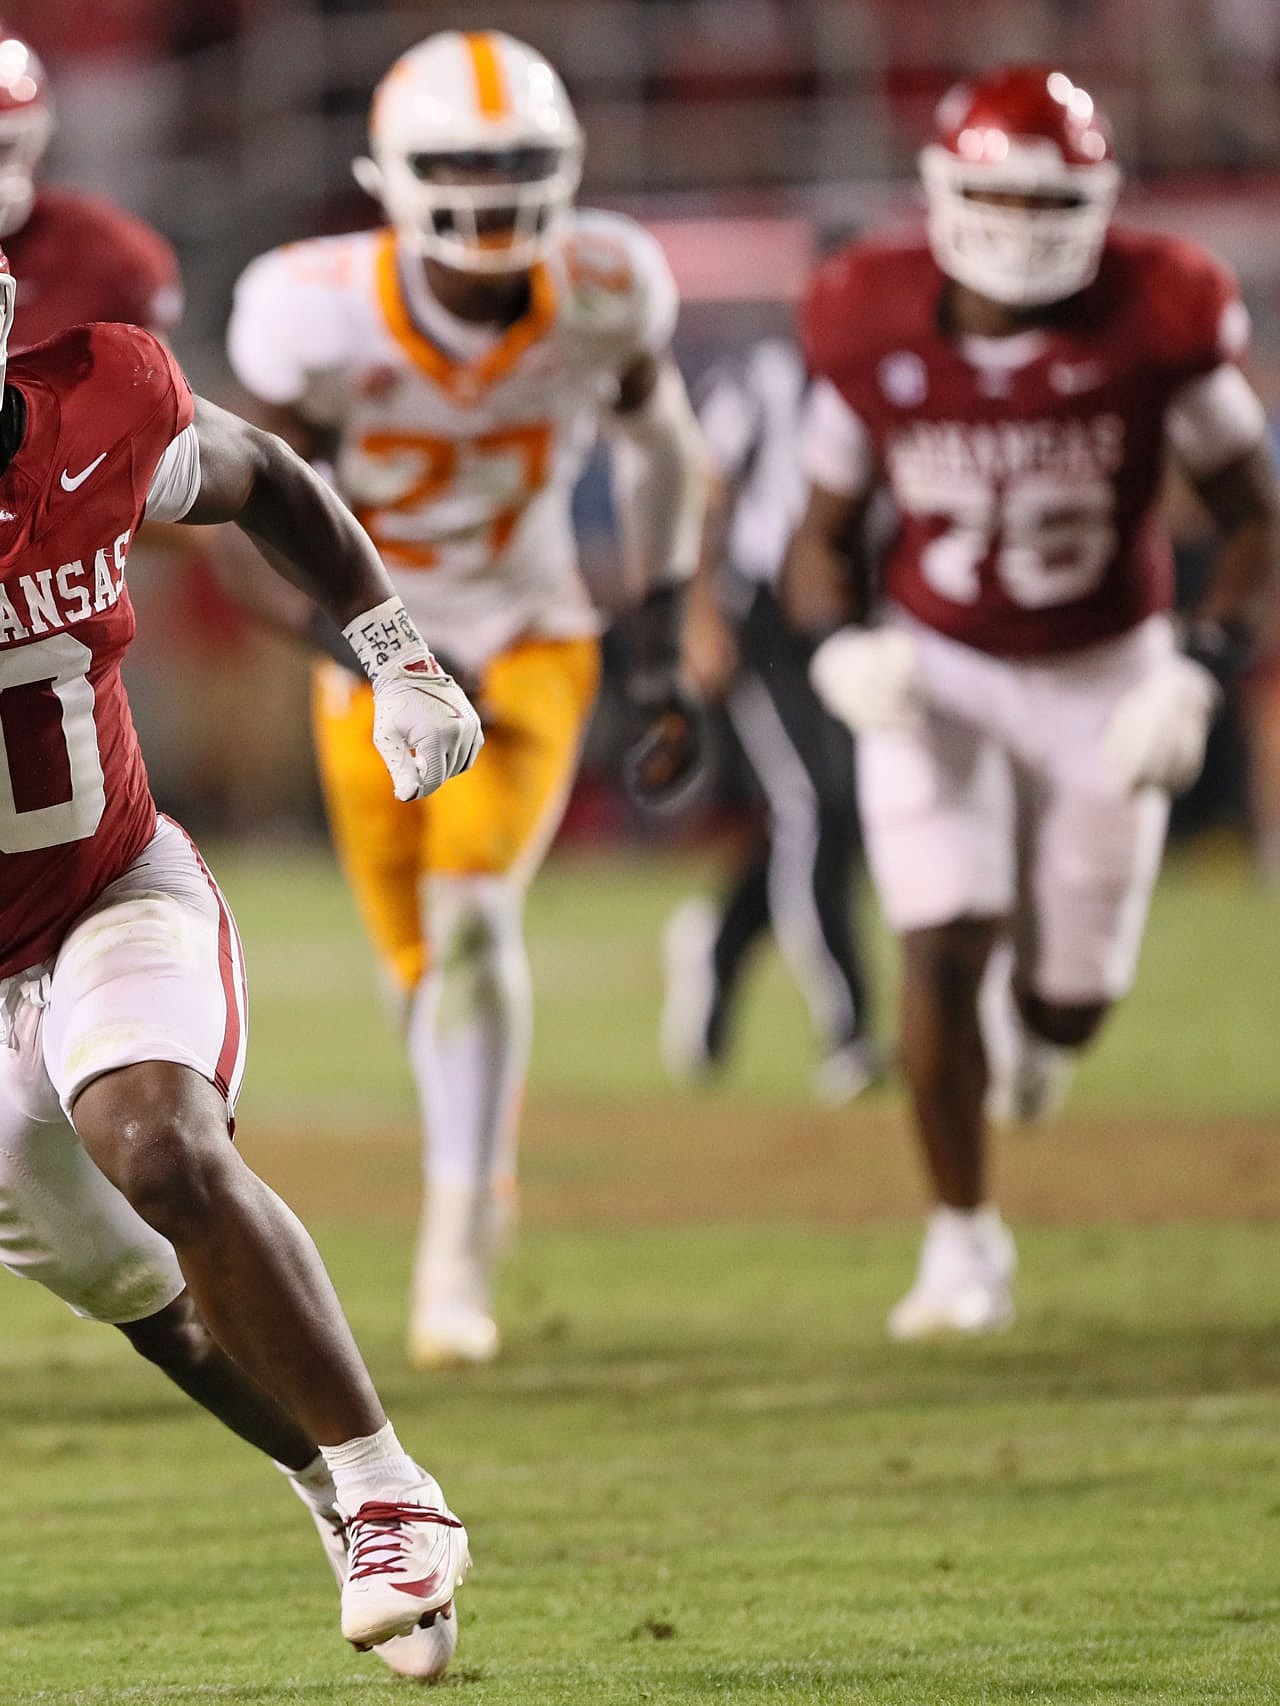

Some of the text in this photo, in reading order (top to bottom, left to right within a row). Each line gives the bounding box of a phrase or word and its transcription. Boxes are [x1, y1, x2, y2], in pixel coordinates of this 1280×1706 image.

[357, 418, 557, 571] 27
[360, 621, 390, 666] Life
[381, 619, 402, 651] In
[394, 607, 421, 646] Rest
